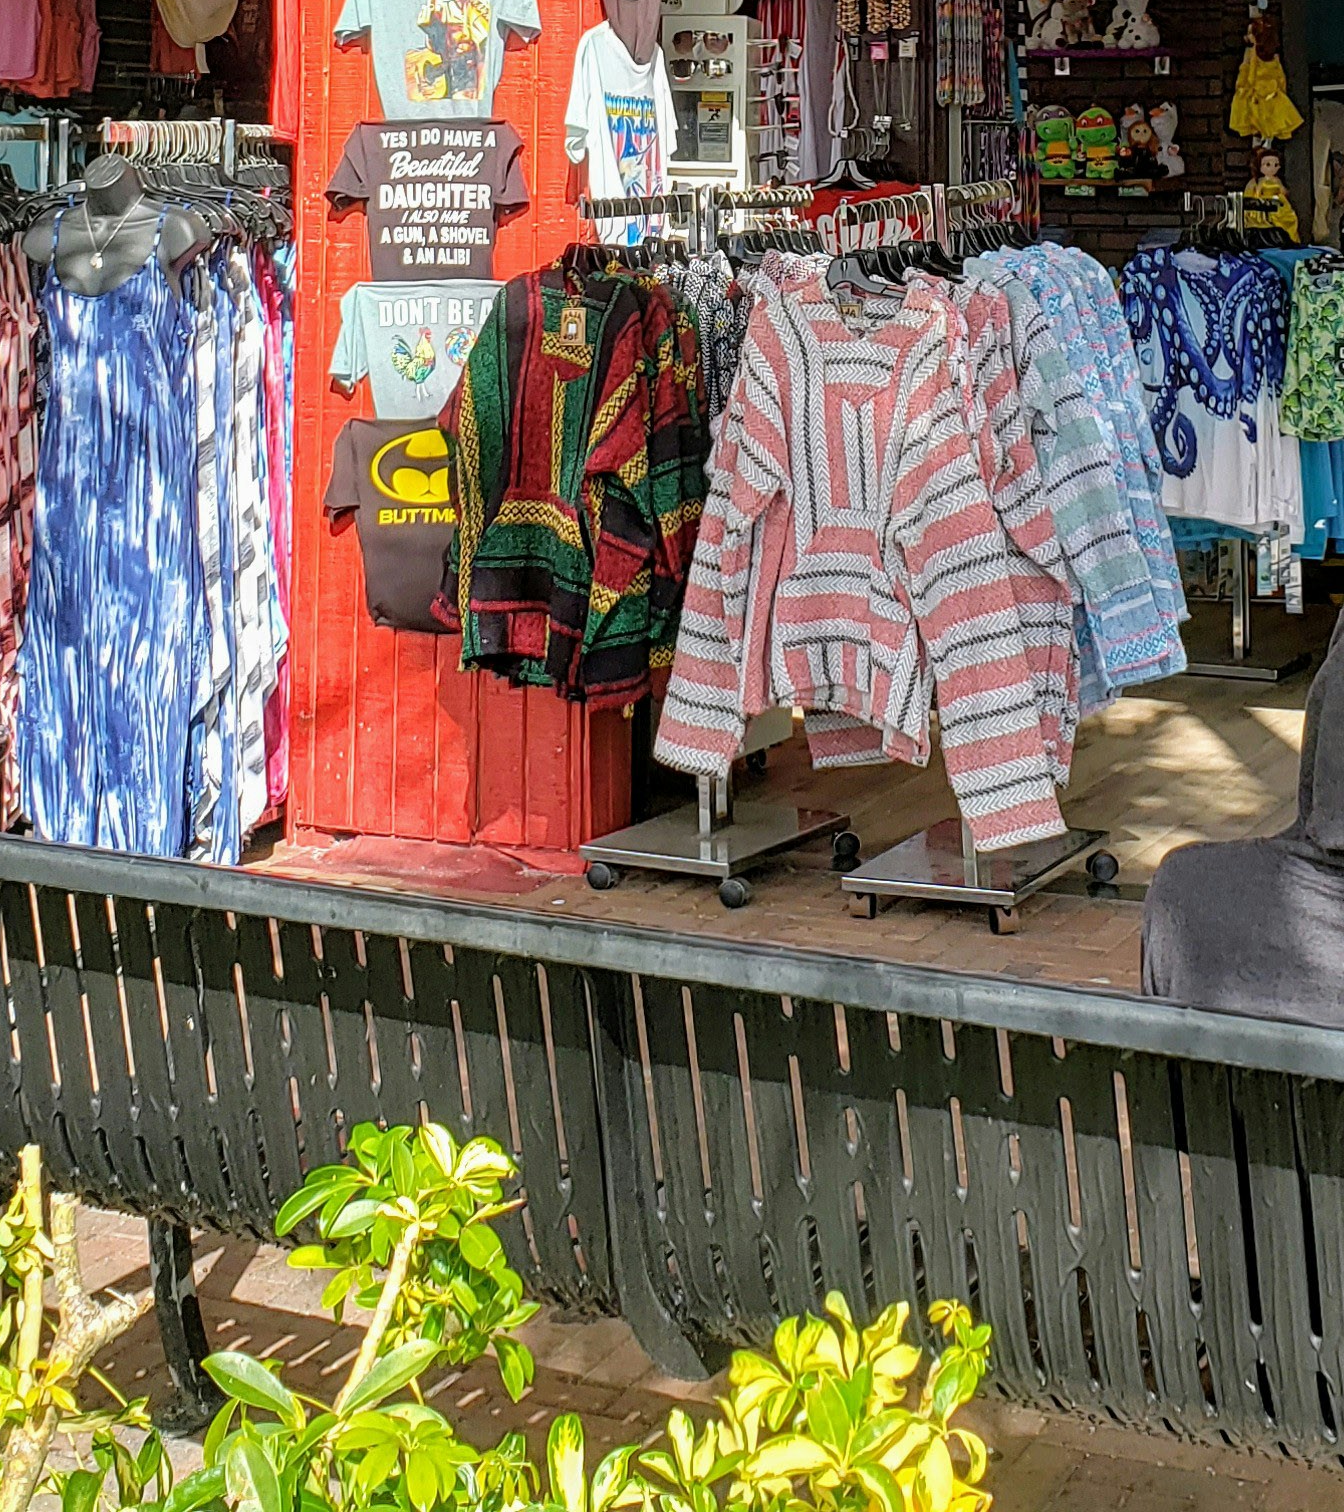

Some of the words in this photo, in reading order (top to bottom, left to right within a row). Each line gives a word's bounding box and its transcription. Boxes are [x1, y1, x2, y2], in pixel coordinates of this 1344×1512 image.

[380, 131, 408, 149] YES
[420, 128, 441, 146] DO
[443, 129, 482, 148] HAVE
[484, 131, 496, 148] A
[389, 150, 484, 182] Beautiful
[379, 182, 492, 210] DAUGHTER
[408, 210, 440, 224] ALSO
[439, 210, 471, 224] HAVE
[380, 227, 391, 244] A
[393, 226, 427, 247] GUN,
[428, 226, 438, 243] A
[440, 226, 490, 245] SHOVEL
[403, 247, 414, 264] &
[416, 247, 436, 264] AN
[436, 247, 471, 265] ALIBI
[378, 296, 441, 327] DON'T
[447, 298, 475, 326] BE
